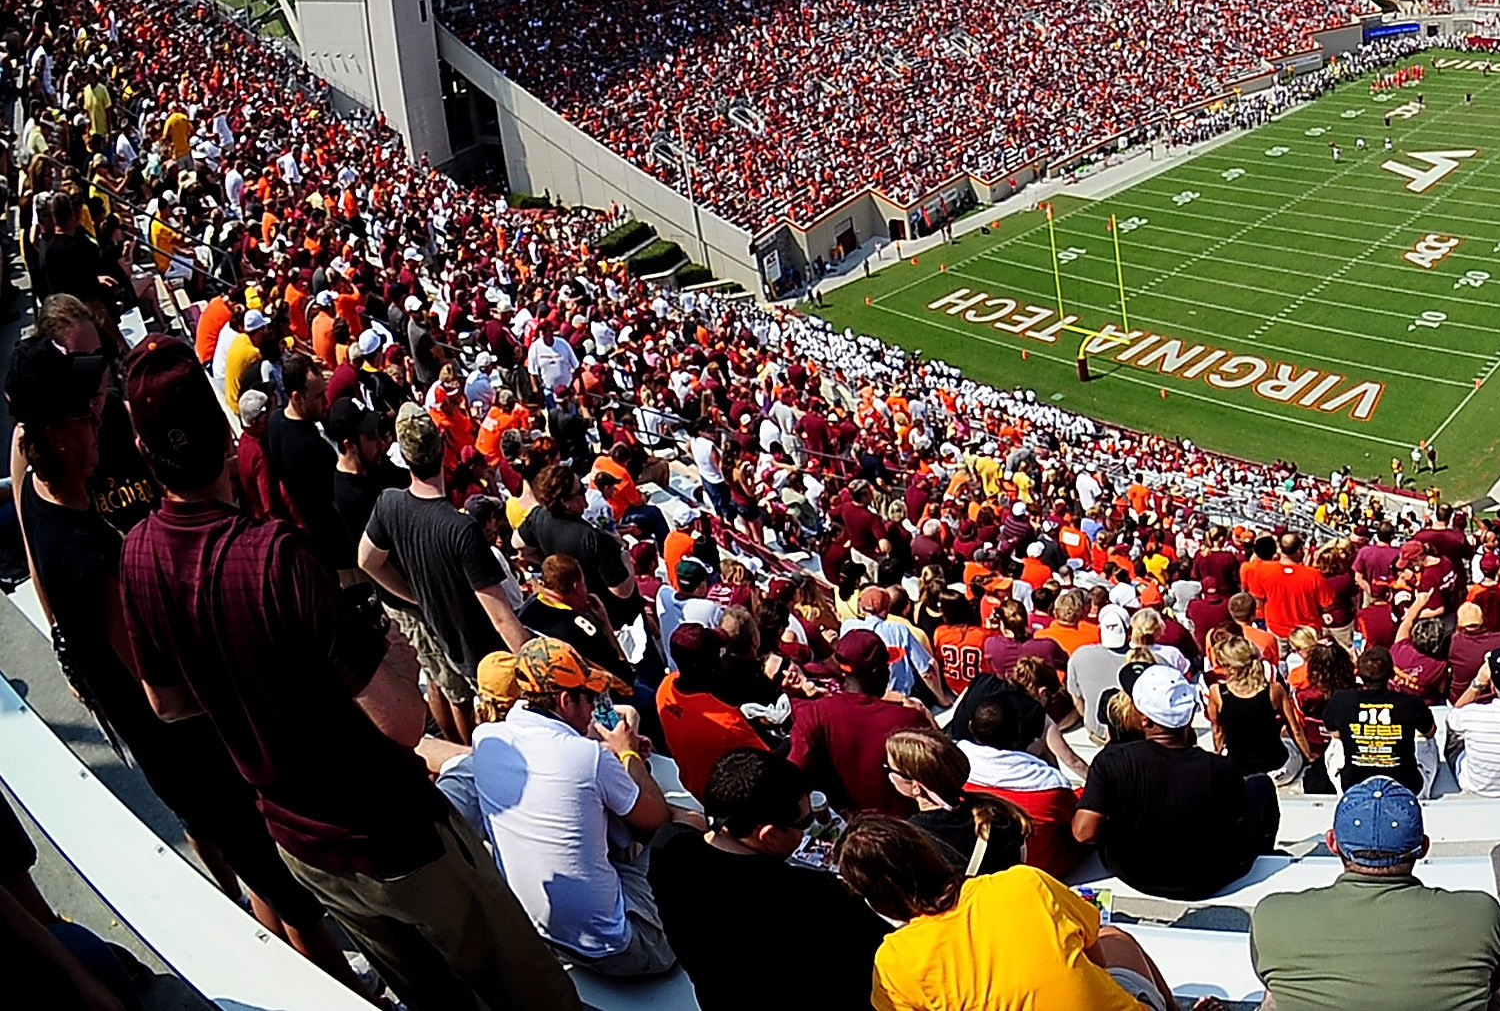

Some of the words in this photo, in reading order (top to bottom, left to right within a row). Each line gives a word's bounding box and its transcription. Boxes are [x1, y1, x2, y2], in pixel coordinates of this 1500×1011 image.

[1403, 233, 1462, 269] ACC
[1458, 270, 1491, 288] 20
[927, 287, 1079, 343] TECH
[1415, 311, 1447, 329] 10
[1085, 322, 1386, 422] VIRGINIA
[574, 615, 597, 637] 8
[941, 644, 982, 682] 28
